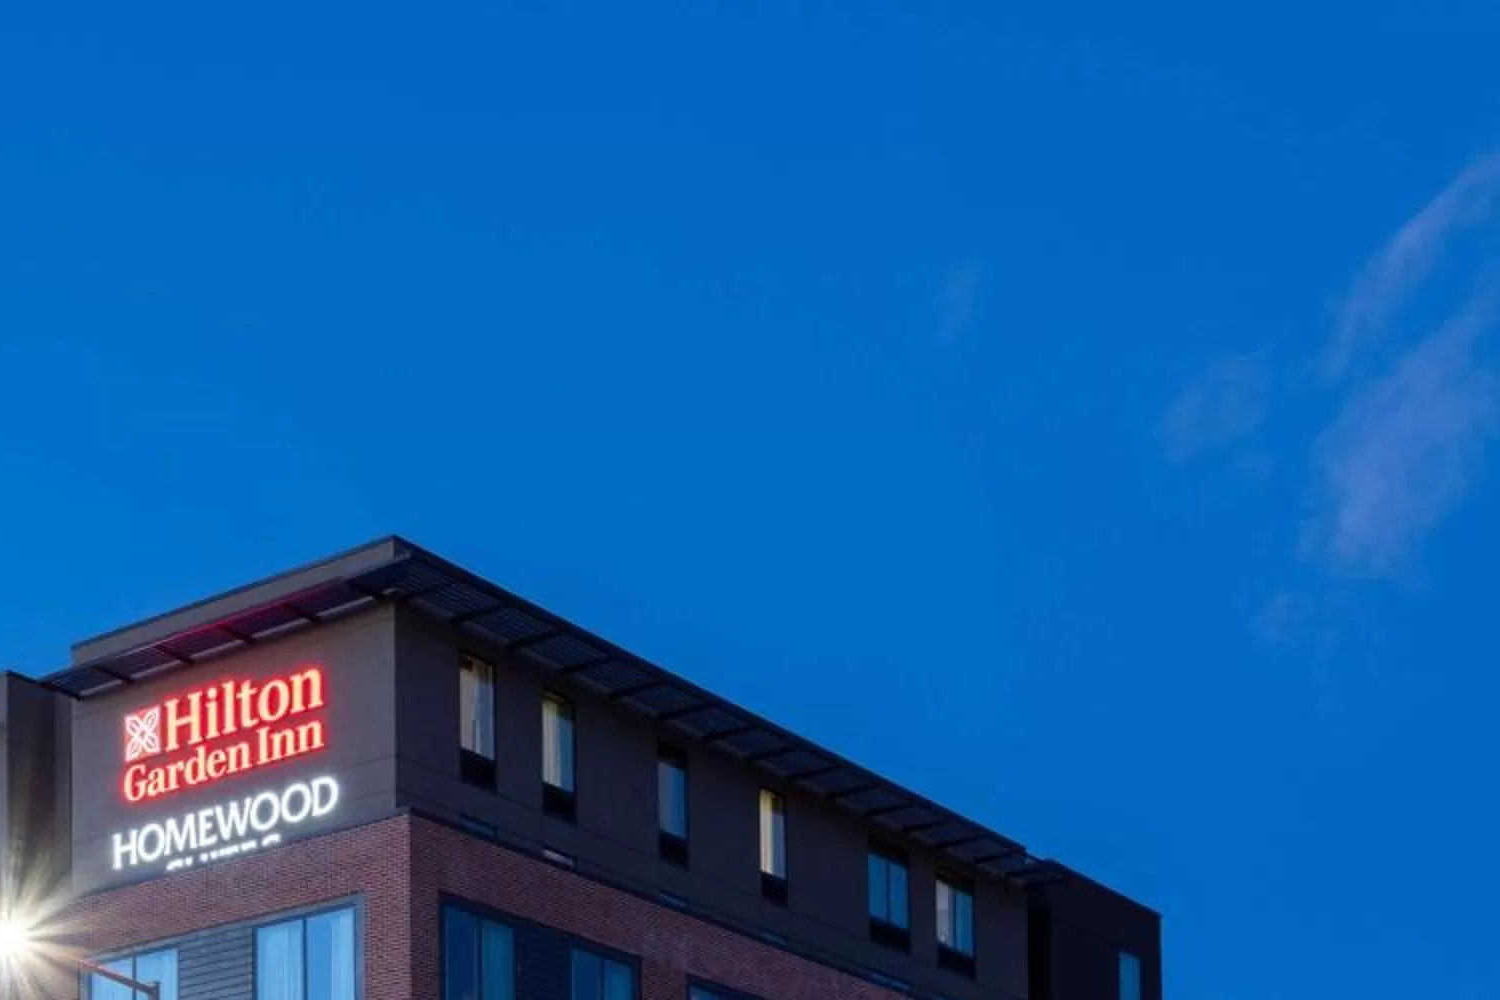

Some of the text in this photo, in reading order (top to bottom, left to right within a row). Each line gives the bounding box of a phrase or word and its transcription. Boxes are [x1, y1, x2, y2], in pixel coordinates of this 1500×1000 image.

[164, 666, 324, 752] Hilton
[122, 719, 324, 802] Garden Inn
[112, 776, 339, 871] HOMEWOOD
